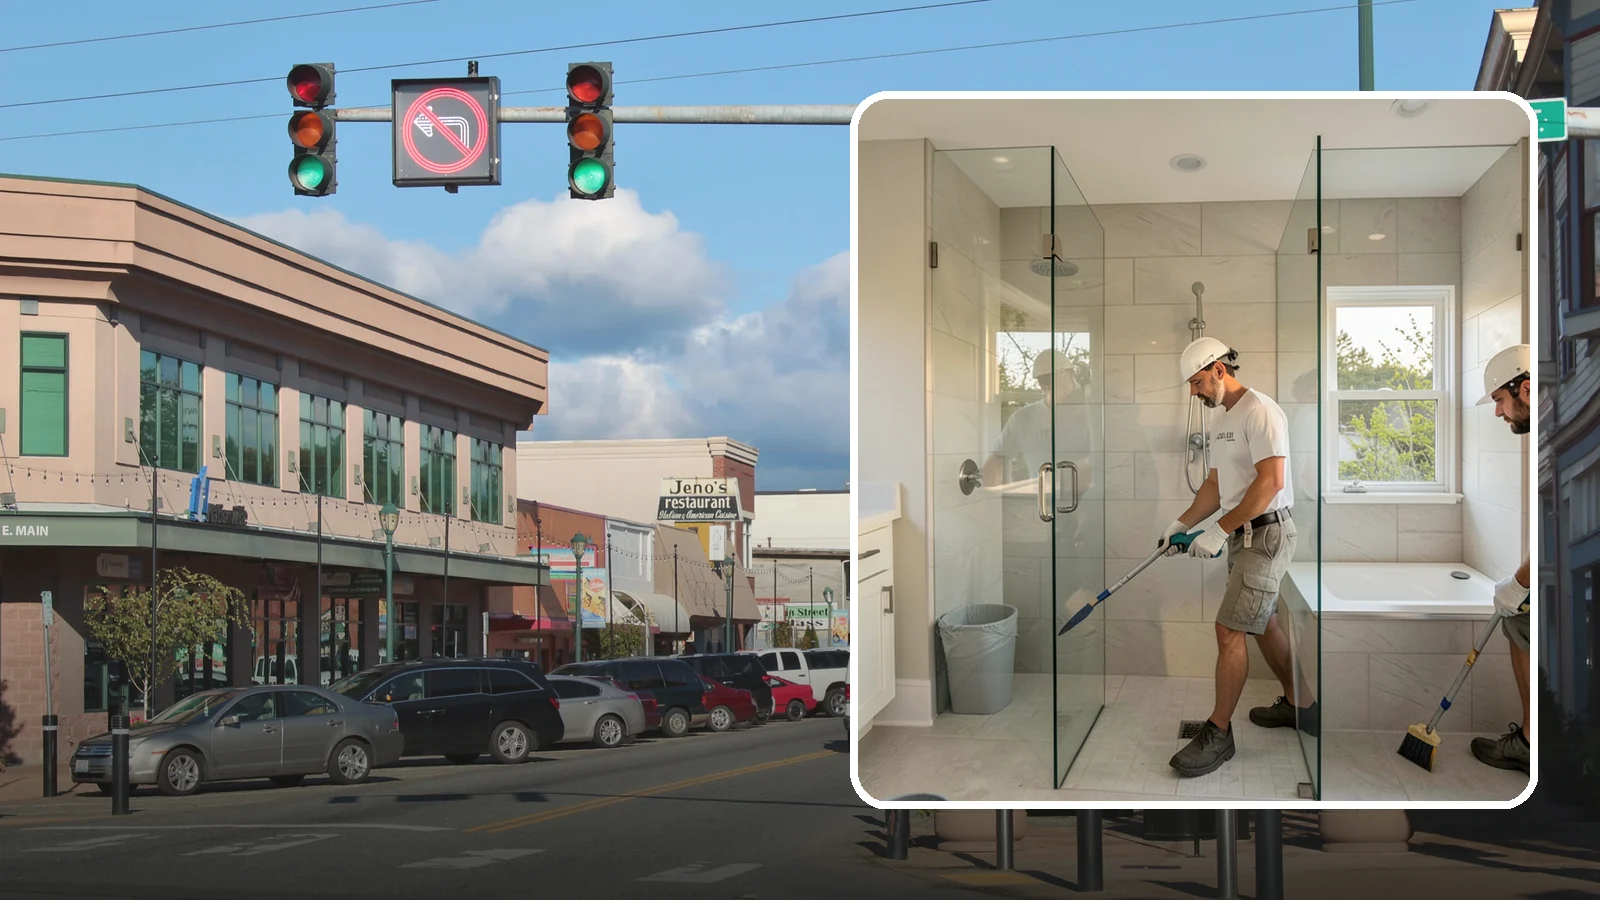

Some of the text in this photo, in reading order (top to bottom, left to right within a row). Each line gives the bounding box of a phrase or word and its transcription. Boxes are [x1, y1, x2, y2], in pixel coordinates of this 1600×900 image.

[670, 480, 727, 494] Jeno's
[665, 496, 730, 508] restaurant
[659, 510, 681, 519] Italian
[686, 510, 715, 519] American
[715, 510, 737, 519] Cuisine
[2, 525, 48, 536] E. MAIN
[786, 608, 828, 616] in Street
[791, 619, 823, 627] lass
